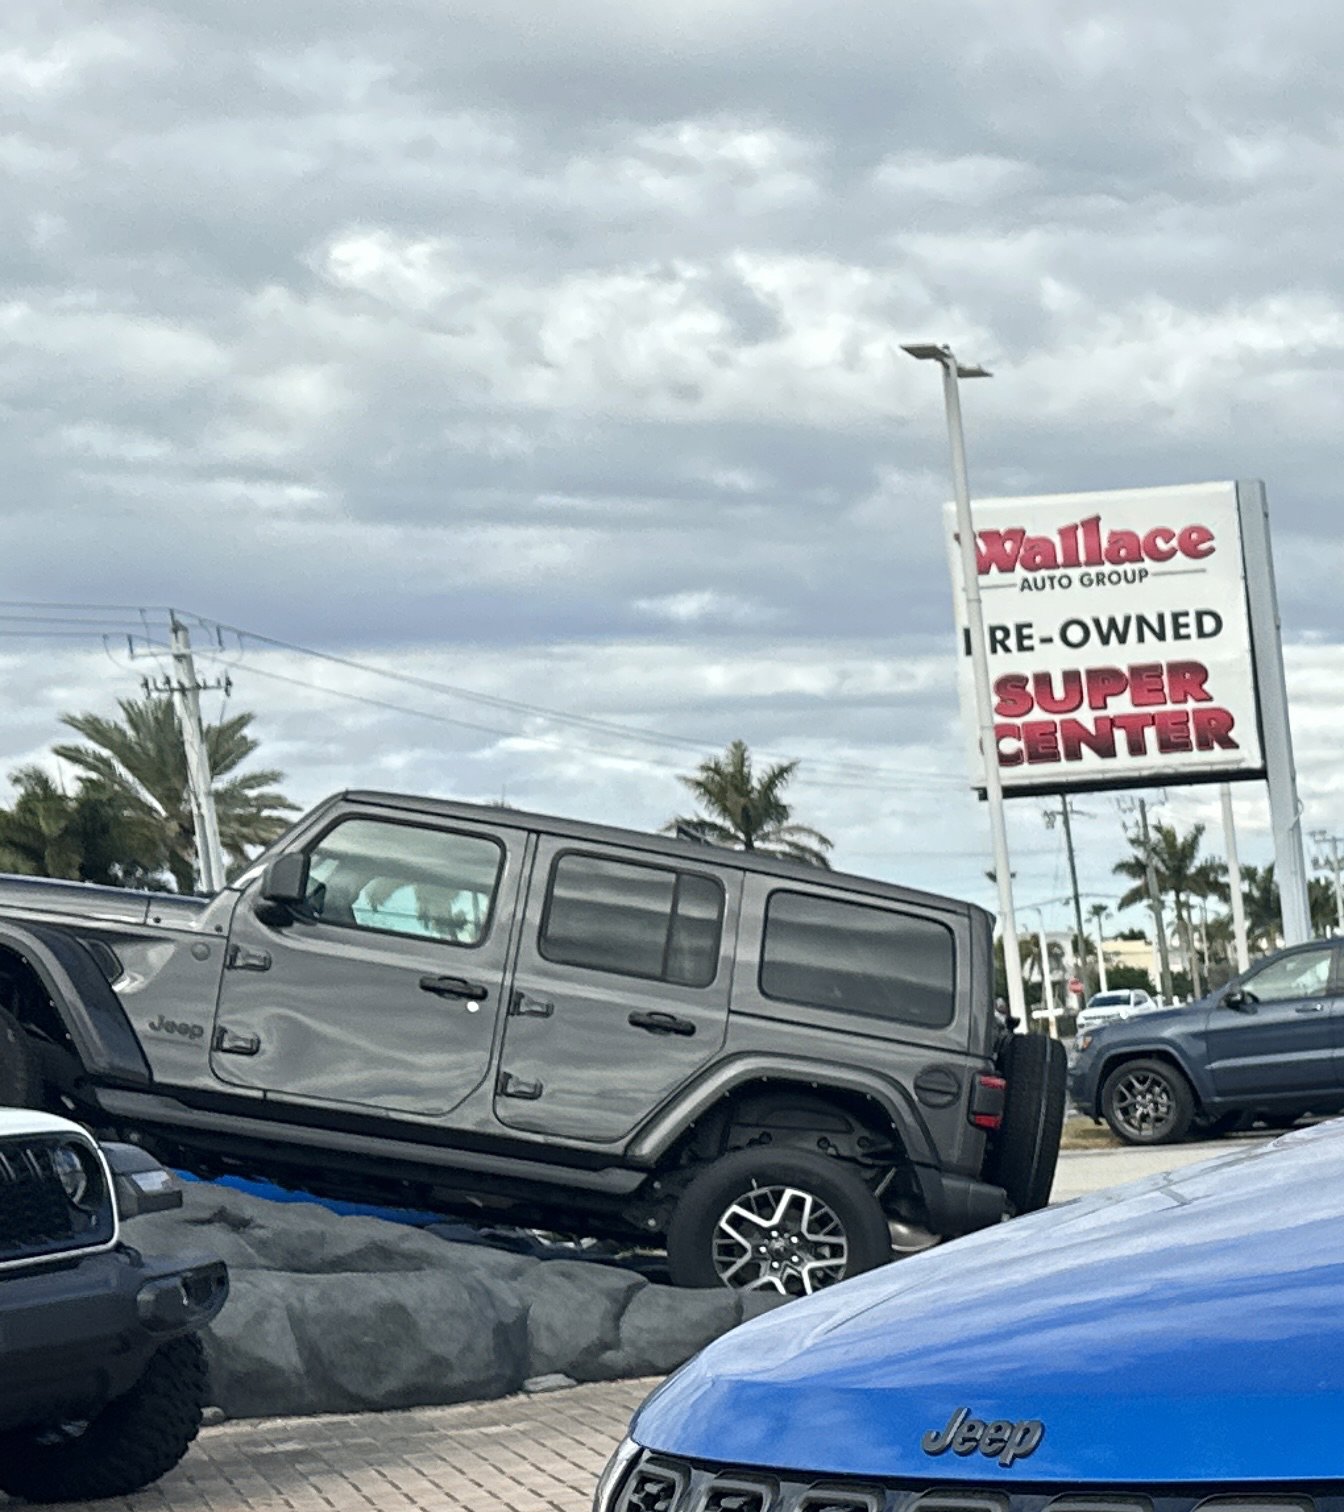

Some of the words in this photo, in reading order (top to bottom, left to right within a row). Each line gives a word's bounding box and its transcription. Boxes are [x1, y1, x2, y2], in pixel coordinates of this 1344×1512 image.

[954, 514, 1216, 575] Wallace
[1019, 574, 1073, 592] AUTO
[1080, 568, 1150, 588] GROUP
[994, 660, 1214, 717] SUPER
[980, 706, 1240, 767] CENTER
[148, 1014, 204, 1040] Jeep
[922, 1406, 1046, 1468] Jeep
